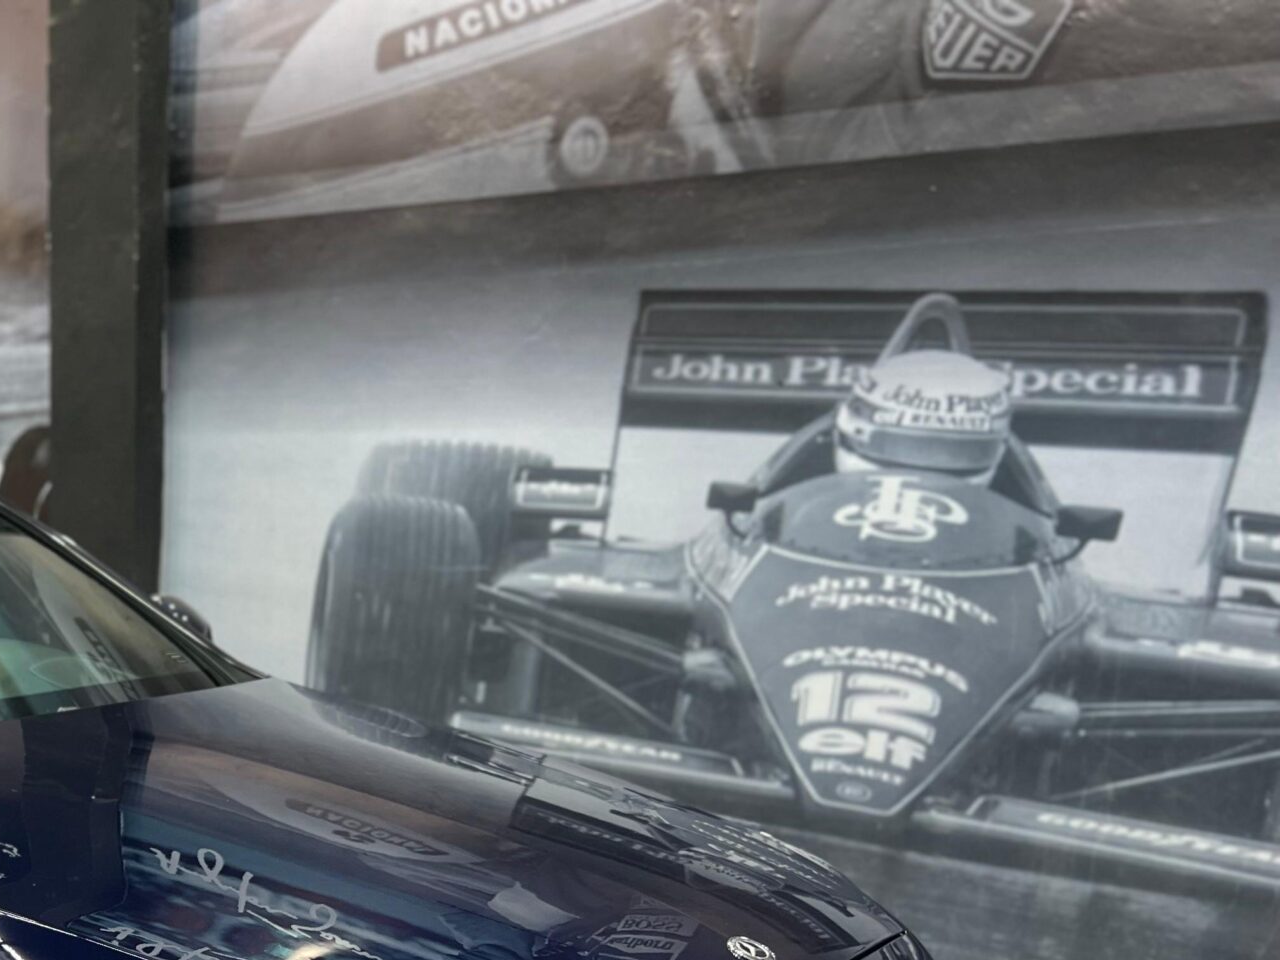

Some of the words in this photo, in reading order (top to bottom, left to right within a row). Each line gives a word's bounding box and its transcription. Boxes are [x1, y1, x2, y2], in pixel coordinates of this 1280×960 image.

[652, 354, 769, 384] John
[784, 356, 872, 387] Pla
[775, 575, 870, 607] John
[882, 573, 998, 625] Player
[810, 591, 957, 625] Special
[782, 646, 969, 692] OLYMPUS
[790, 670, 942, 745] 12
[798, 727, 927, 770] elf
[1036, 812, 1280, 865] GOODYEA
